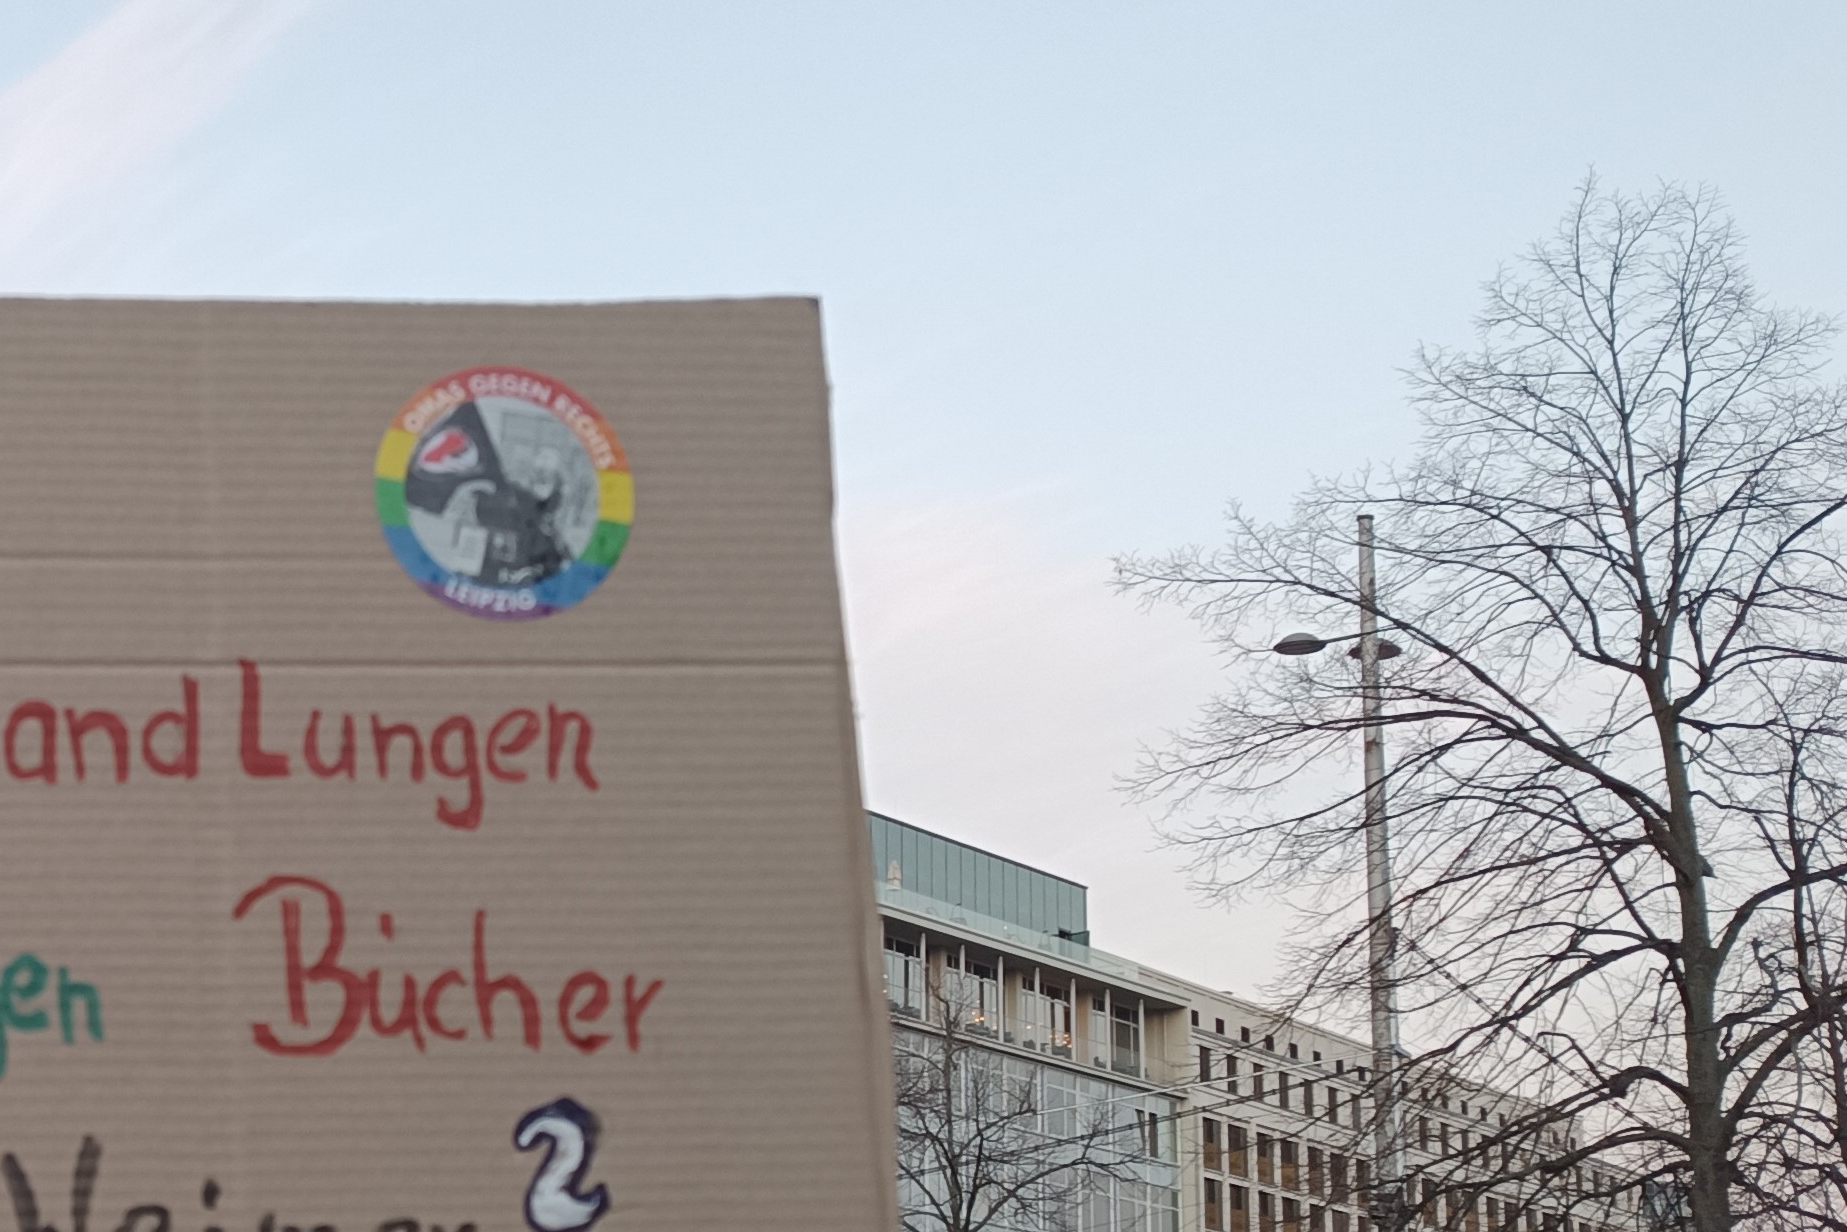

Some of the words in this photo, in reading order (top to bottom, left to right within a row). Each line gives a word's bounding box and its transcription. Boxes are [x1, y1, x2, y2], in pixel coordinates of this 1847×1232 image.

[403, 379, 466, 433] OMAS
[467, 373, 553, 403] GEGEN
[444, 578, 537, 612] LEIPZIG
